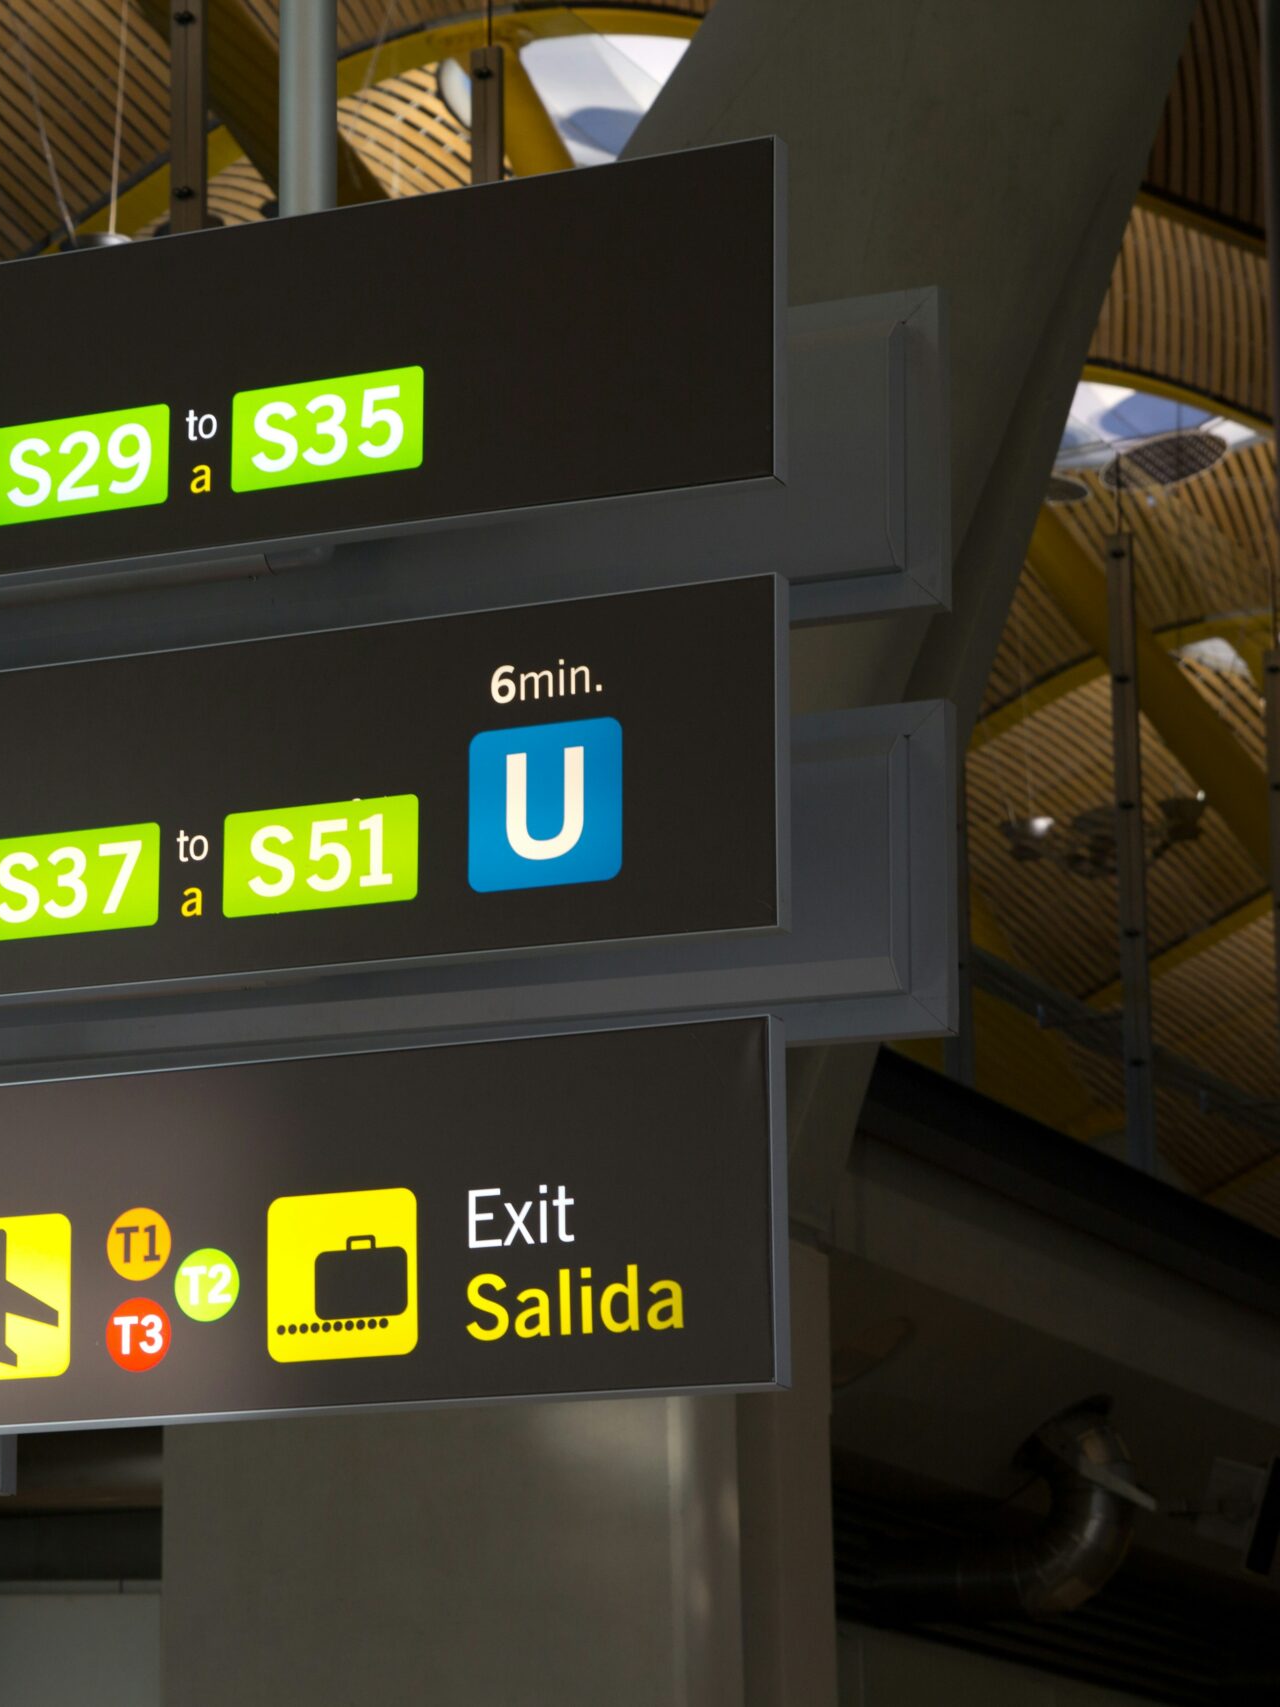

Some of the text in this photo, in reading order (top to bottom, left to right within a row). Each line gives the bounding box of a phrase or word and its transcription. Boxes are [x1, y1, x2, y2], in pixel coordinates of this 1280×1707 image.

[7, 386, 404, 507] S29 to S35
[190, 464, 211, 494] a
[504, 745, 585, 861] U
[176, 829, 209, 863] to
[249, 813, 394, 897] S51
[181, 886, 203, 918] a
[468, 1184, 576, 1249] Exit
[116, 1224, 161, 1264] T1
[182, 1264, 232, 1305] T2
[466, 1262, 684, 1342] Salida
[113, 1313, 163, 1355] T3
